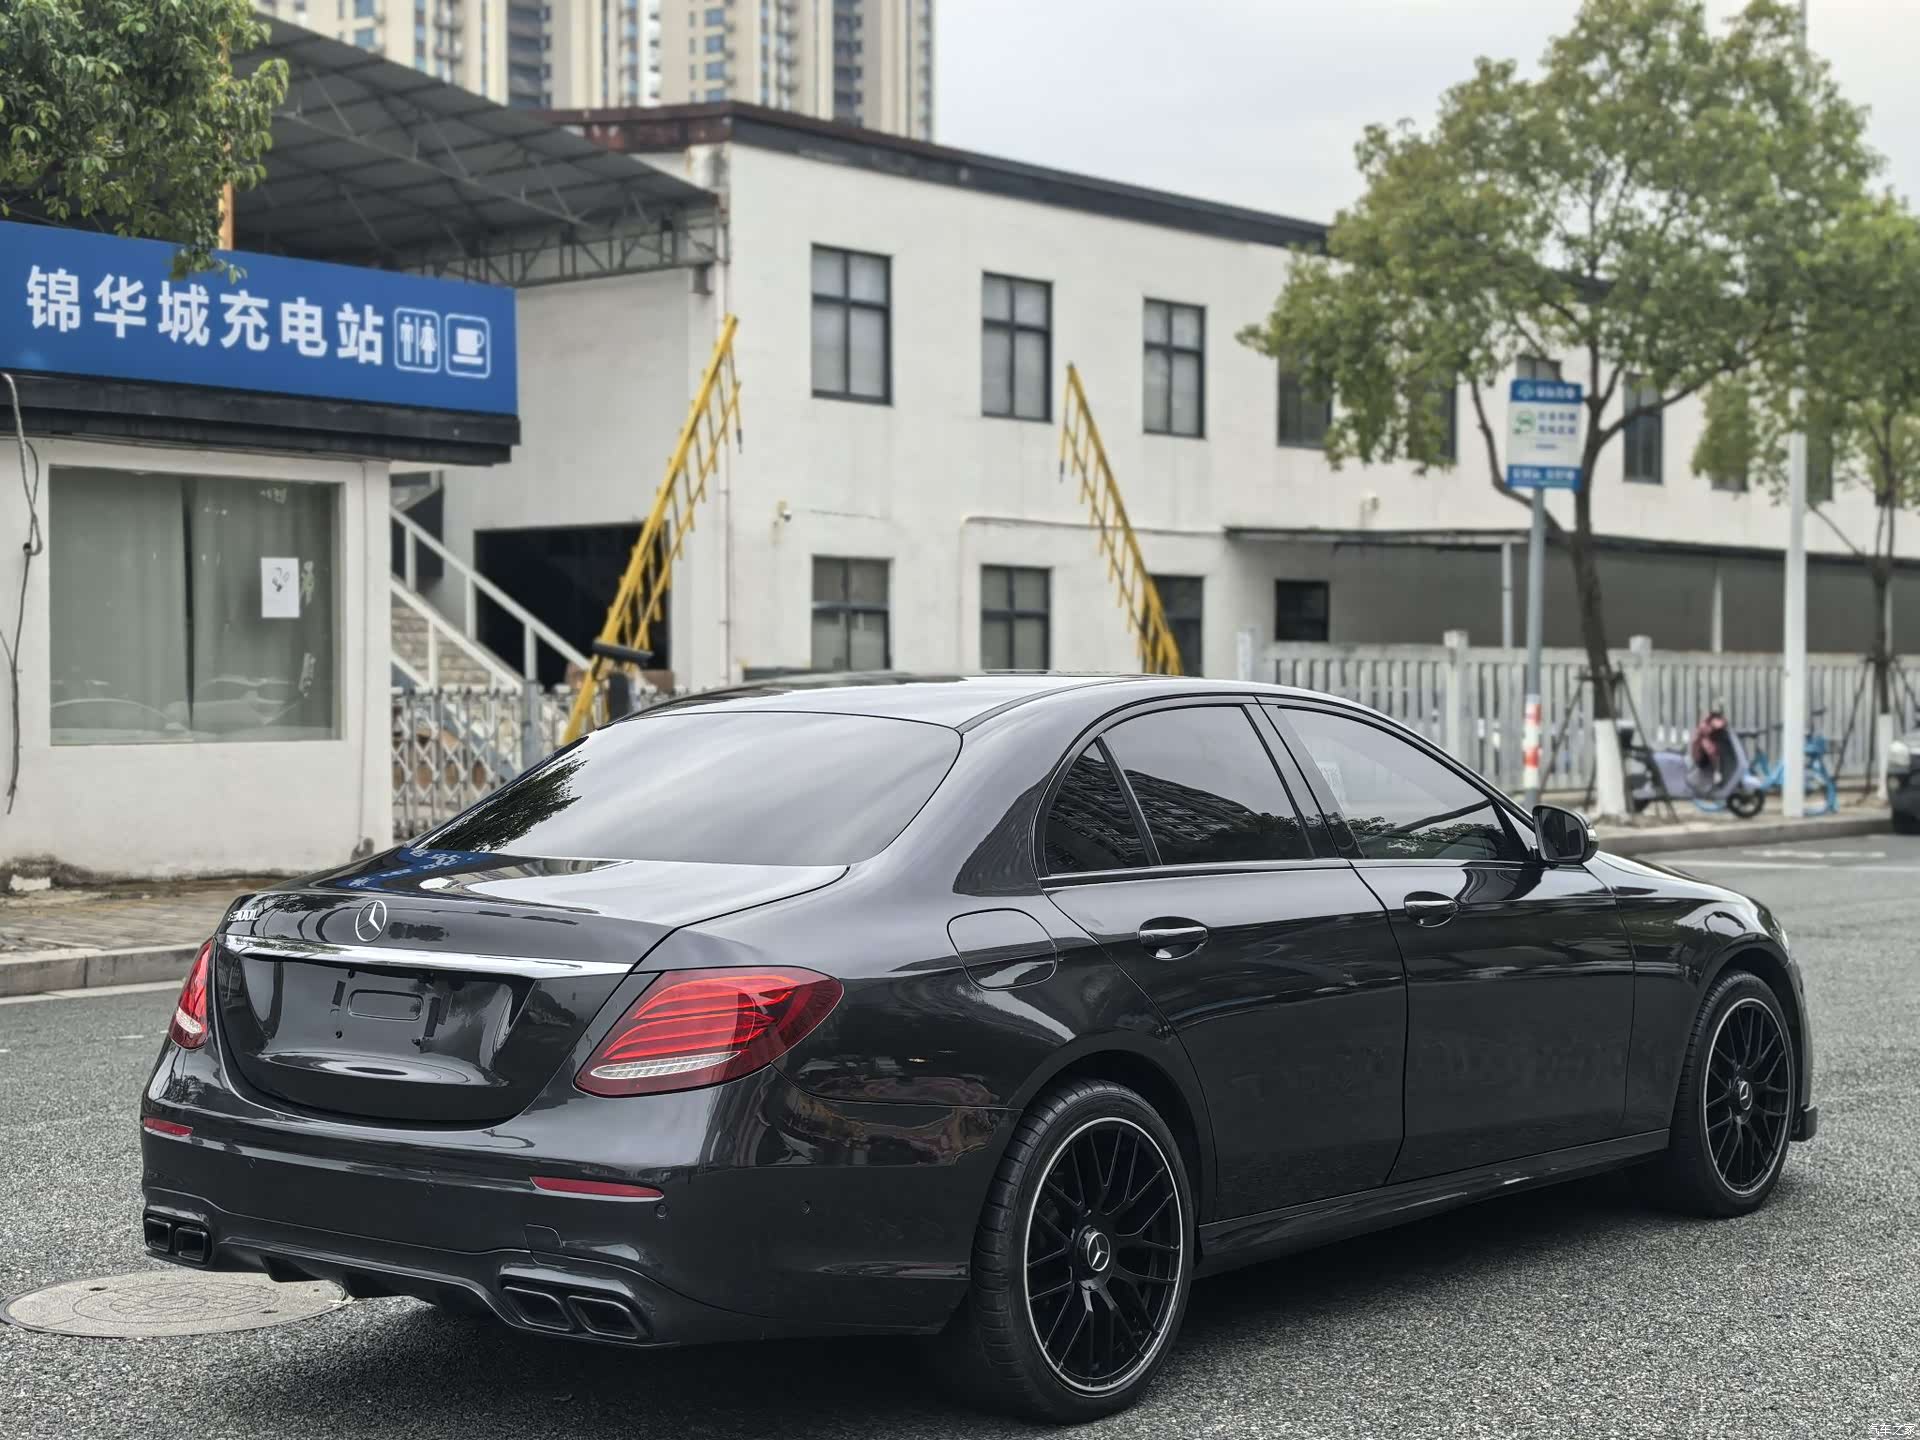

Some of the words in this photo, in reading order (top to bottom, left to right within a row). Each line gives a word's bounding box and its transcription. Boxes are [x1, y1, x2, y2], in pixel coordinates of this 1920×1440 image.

[26, 265, 384, 365] 锦华城充电站
